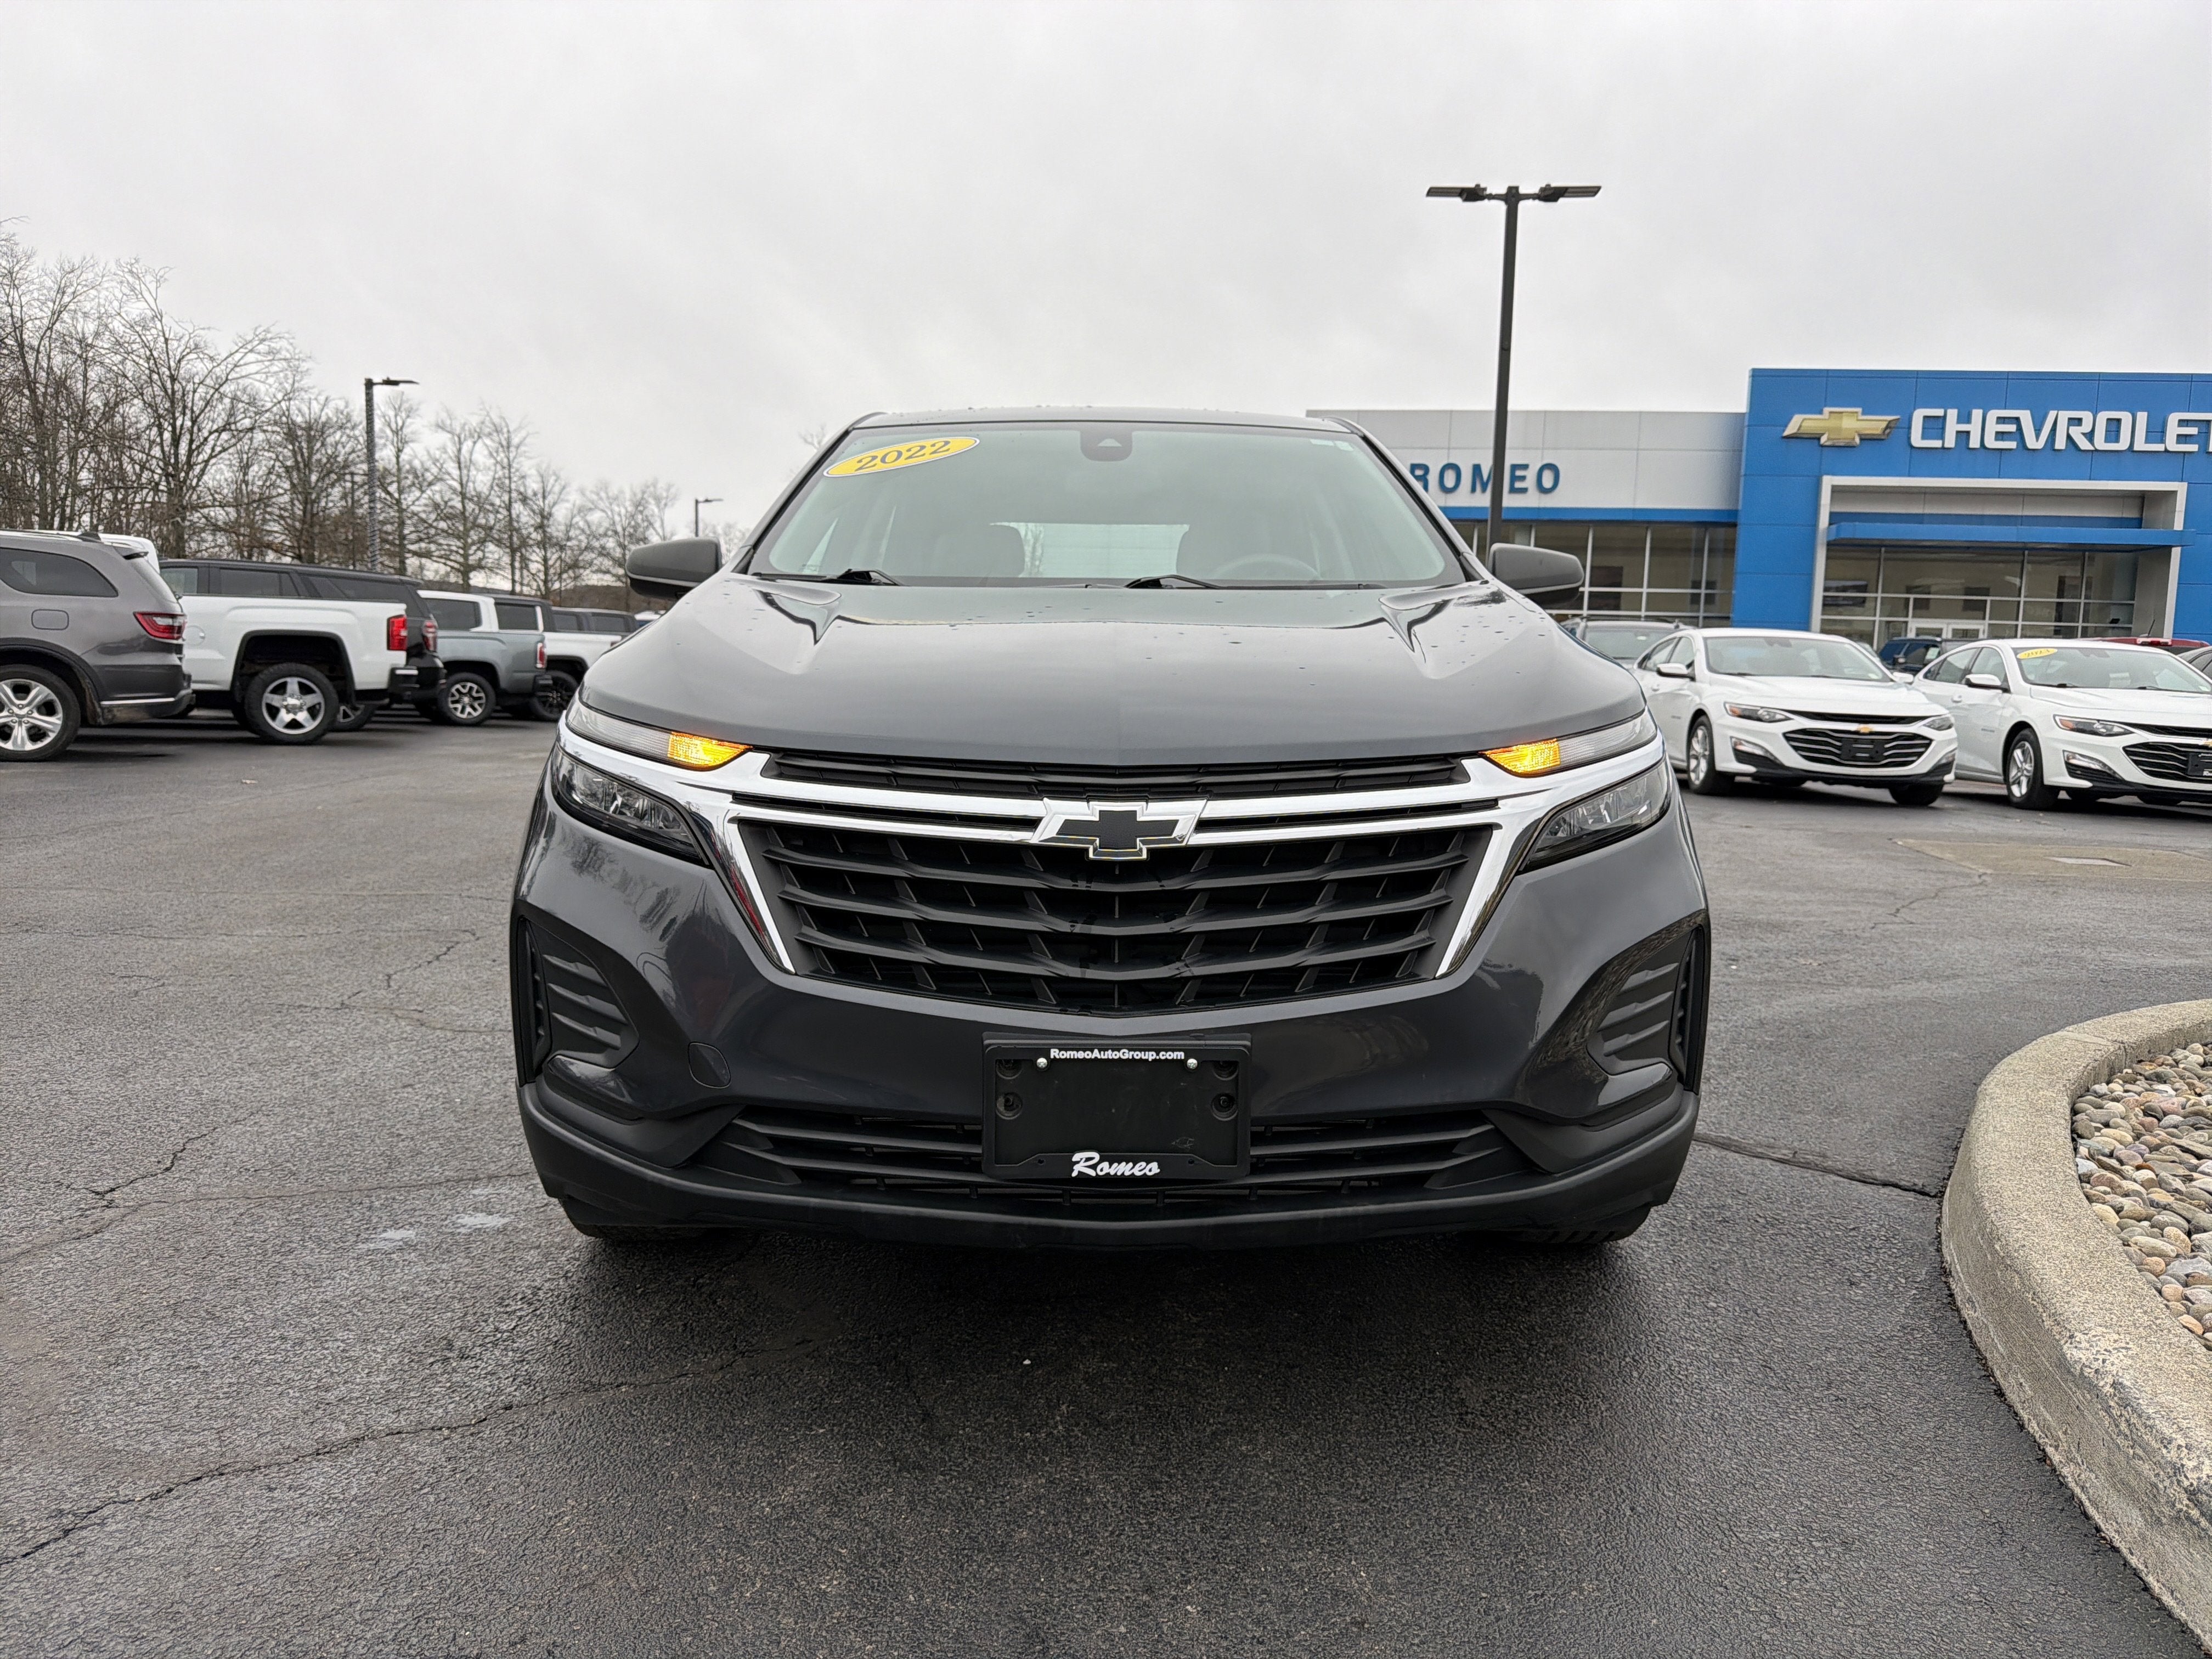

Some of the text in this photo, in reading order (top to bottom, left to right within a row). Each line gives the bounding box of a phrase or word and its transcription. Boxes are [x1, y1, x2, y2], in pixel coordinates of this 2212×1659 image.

[1910, 408, 2212, 452] CHEVROLE
[854, 440, 951, 472] 2022
[1050, 1048, 1184, 1061] RomeoAutoGroup.com
[1071, 1152, 1160, 1177] Romeo
